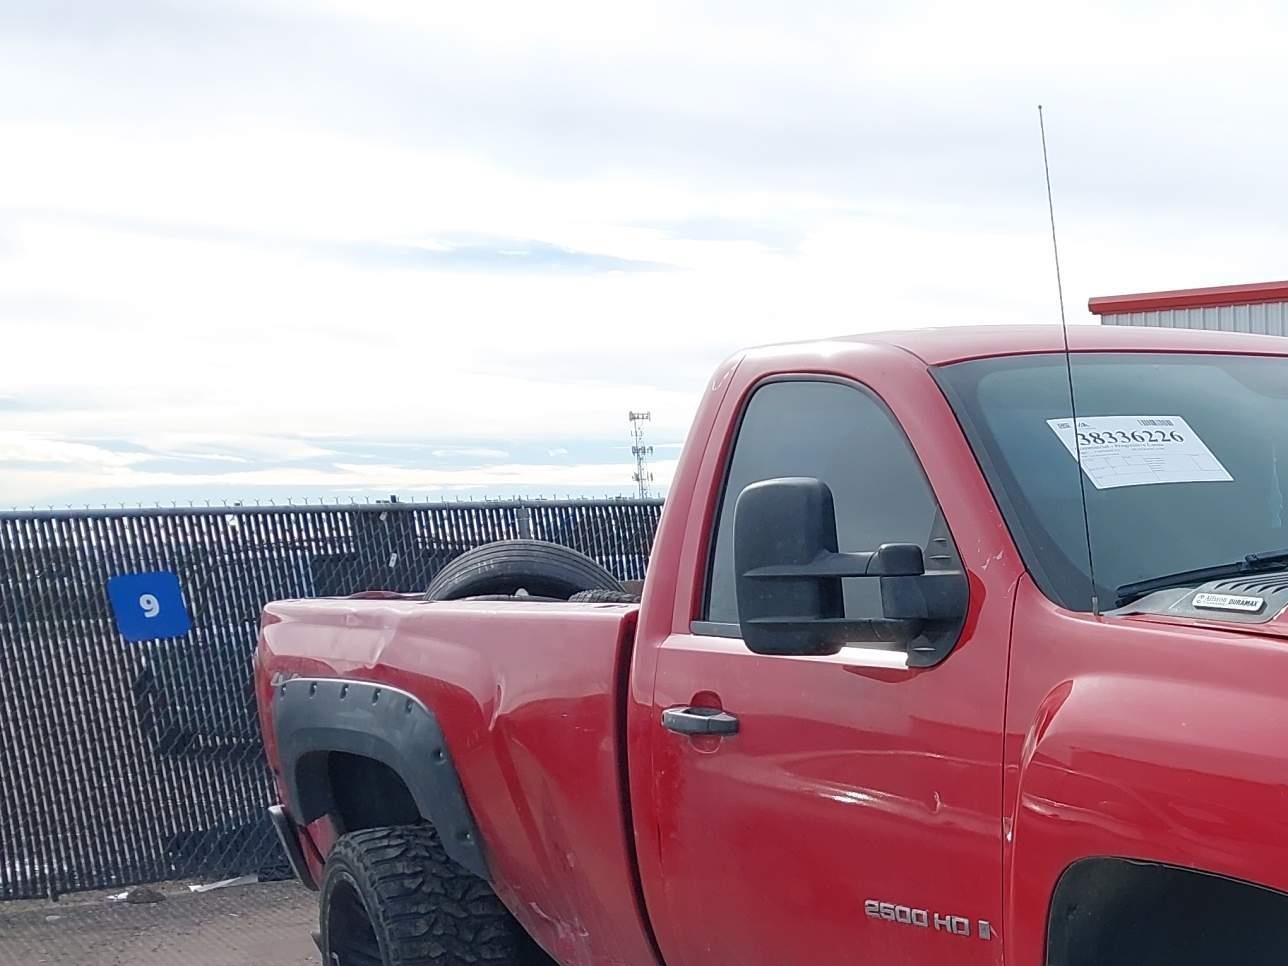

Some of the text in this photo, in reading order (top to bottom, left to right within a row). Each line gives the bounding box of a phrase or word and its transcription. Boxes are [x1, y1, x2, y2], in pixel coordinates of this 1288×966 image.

[1076, 430, 1185, 446] 38336226
[139, 594, 160, 618] 9
[864, 899, 971, 937] 2500 HD
